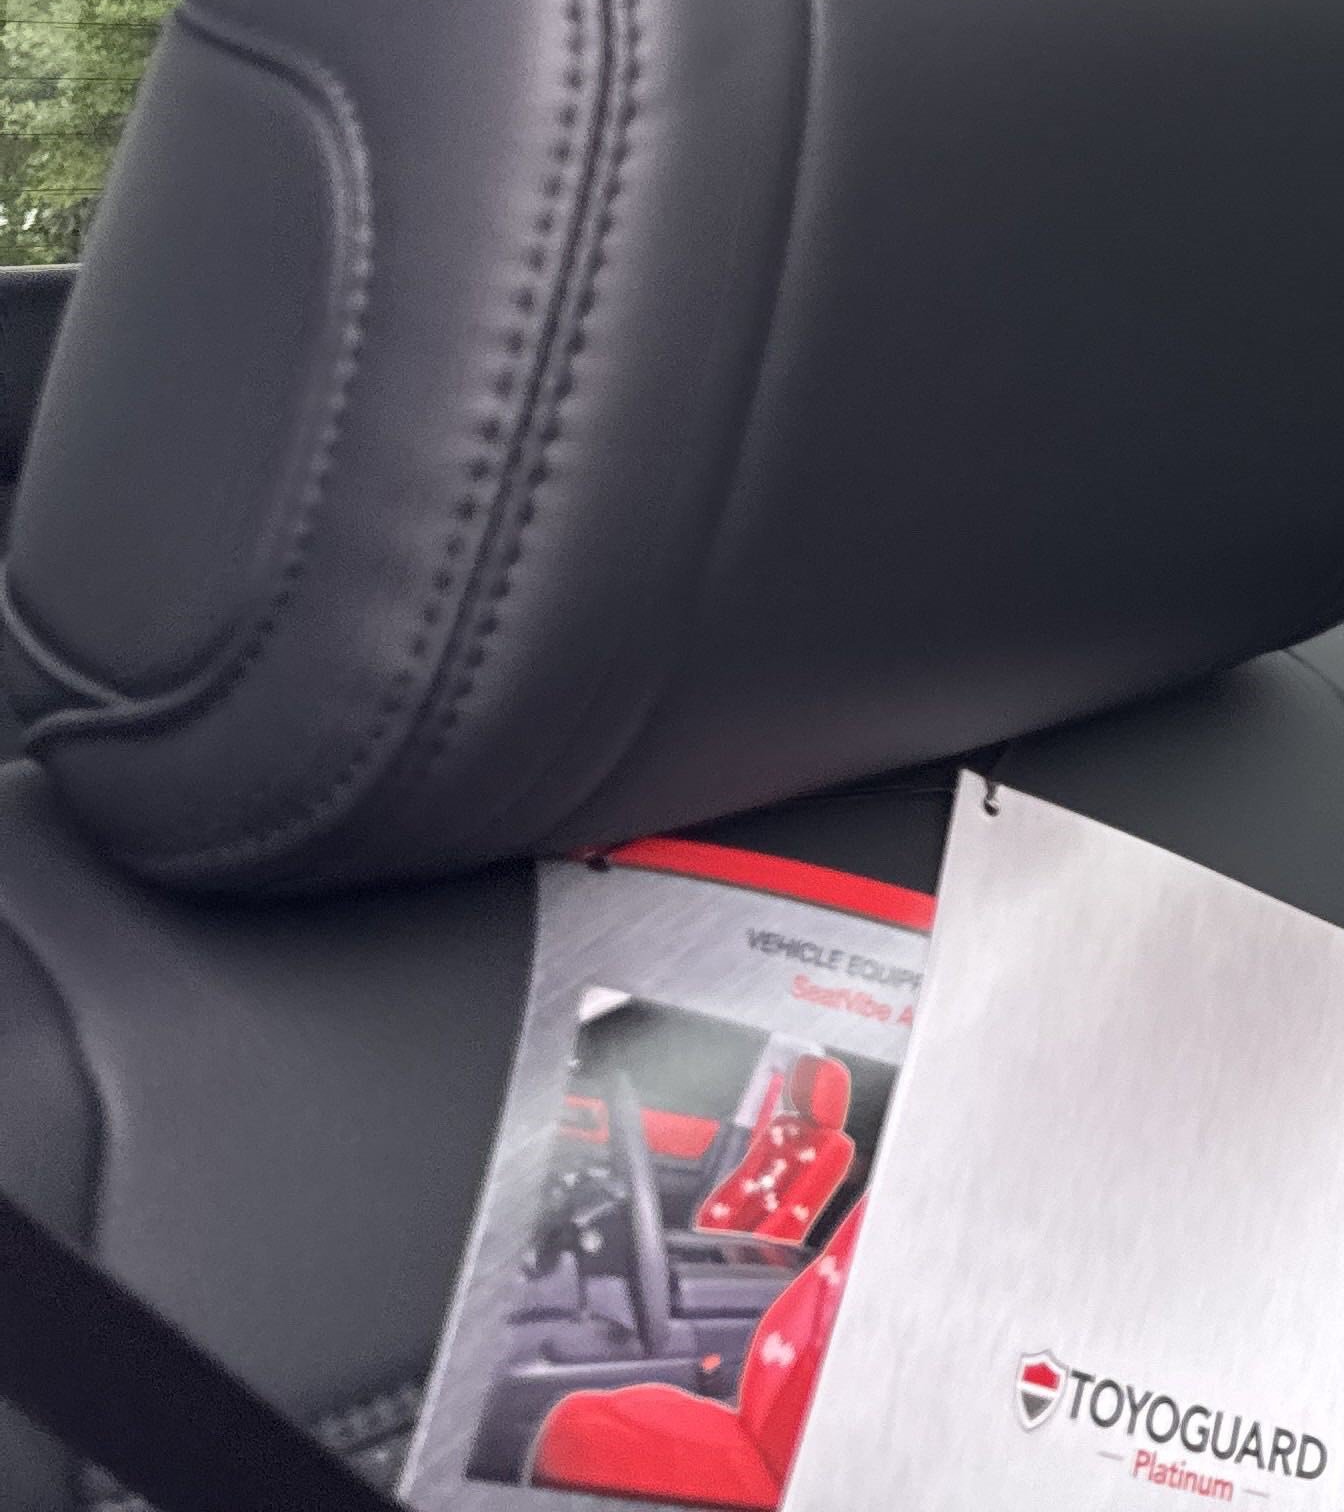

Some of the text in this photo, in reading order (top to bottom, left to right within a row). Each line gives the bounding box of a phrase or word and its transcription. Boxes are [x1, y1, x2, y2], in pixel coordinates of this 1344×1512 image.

[746, 928, 844, 969] VEHICLE
[1068, 1369, 1328, 1480] TOYOGUARD
[1132, 1449, 1234, 1501] Platinum
